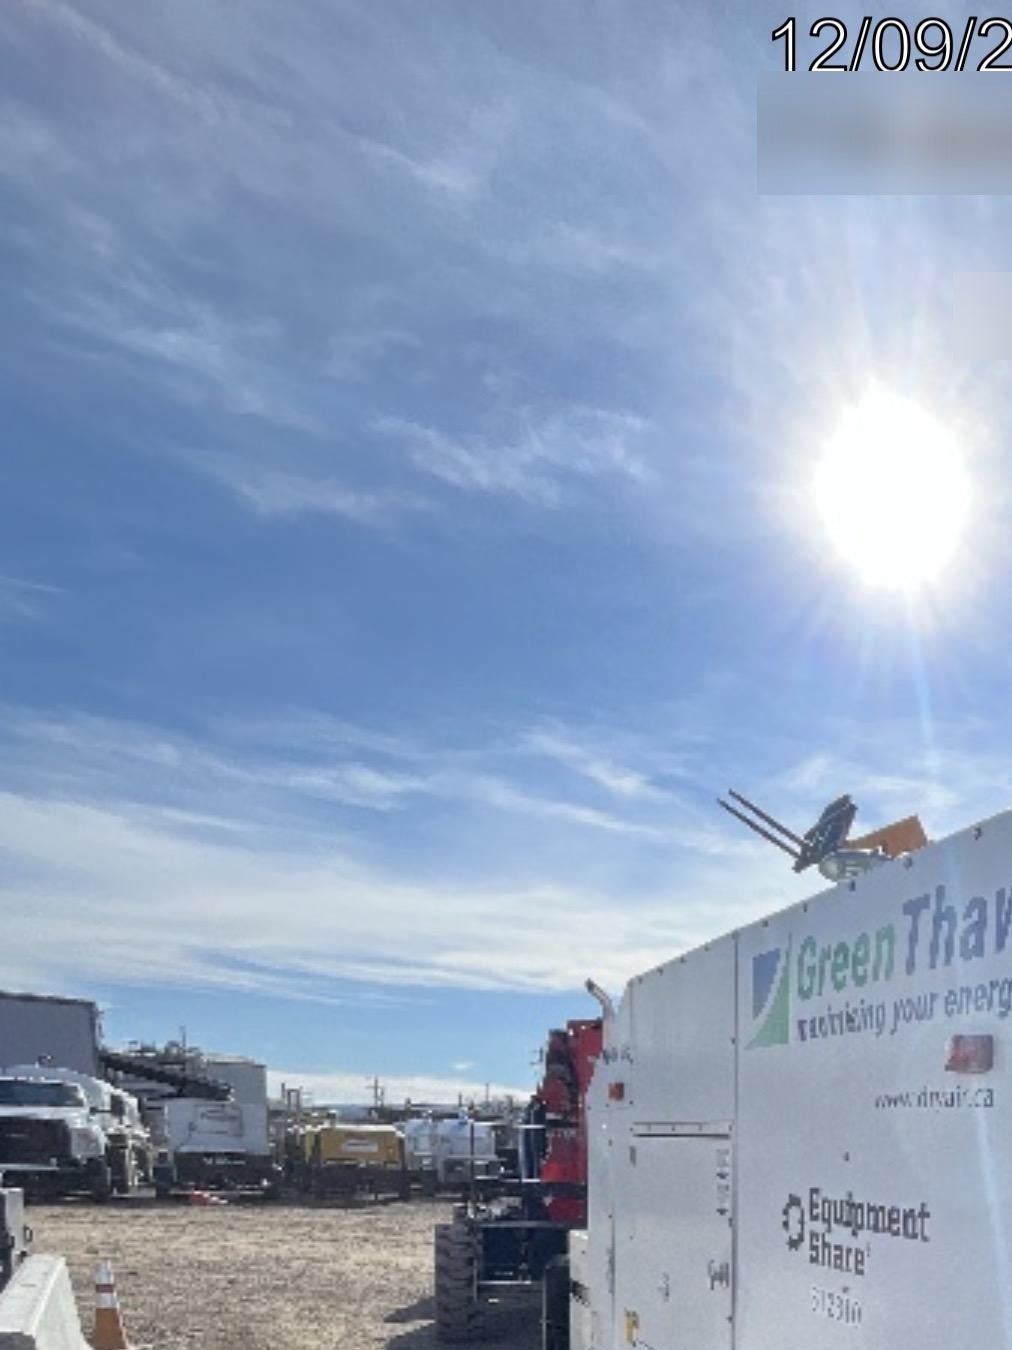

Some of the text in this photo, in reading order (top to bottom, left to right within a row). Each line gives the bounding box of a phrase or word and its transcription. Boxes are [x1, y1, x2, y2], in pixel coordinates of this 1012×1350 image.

[891, 992, 940, 1035] your
[809, 1187, 931, 1242] Equipment
[809, 1230, 865, 1275] Share
